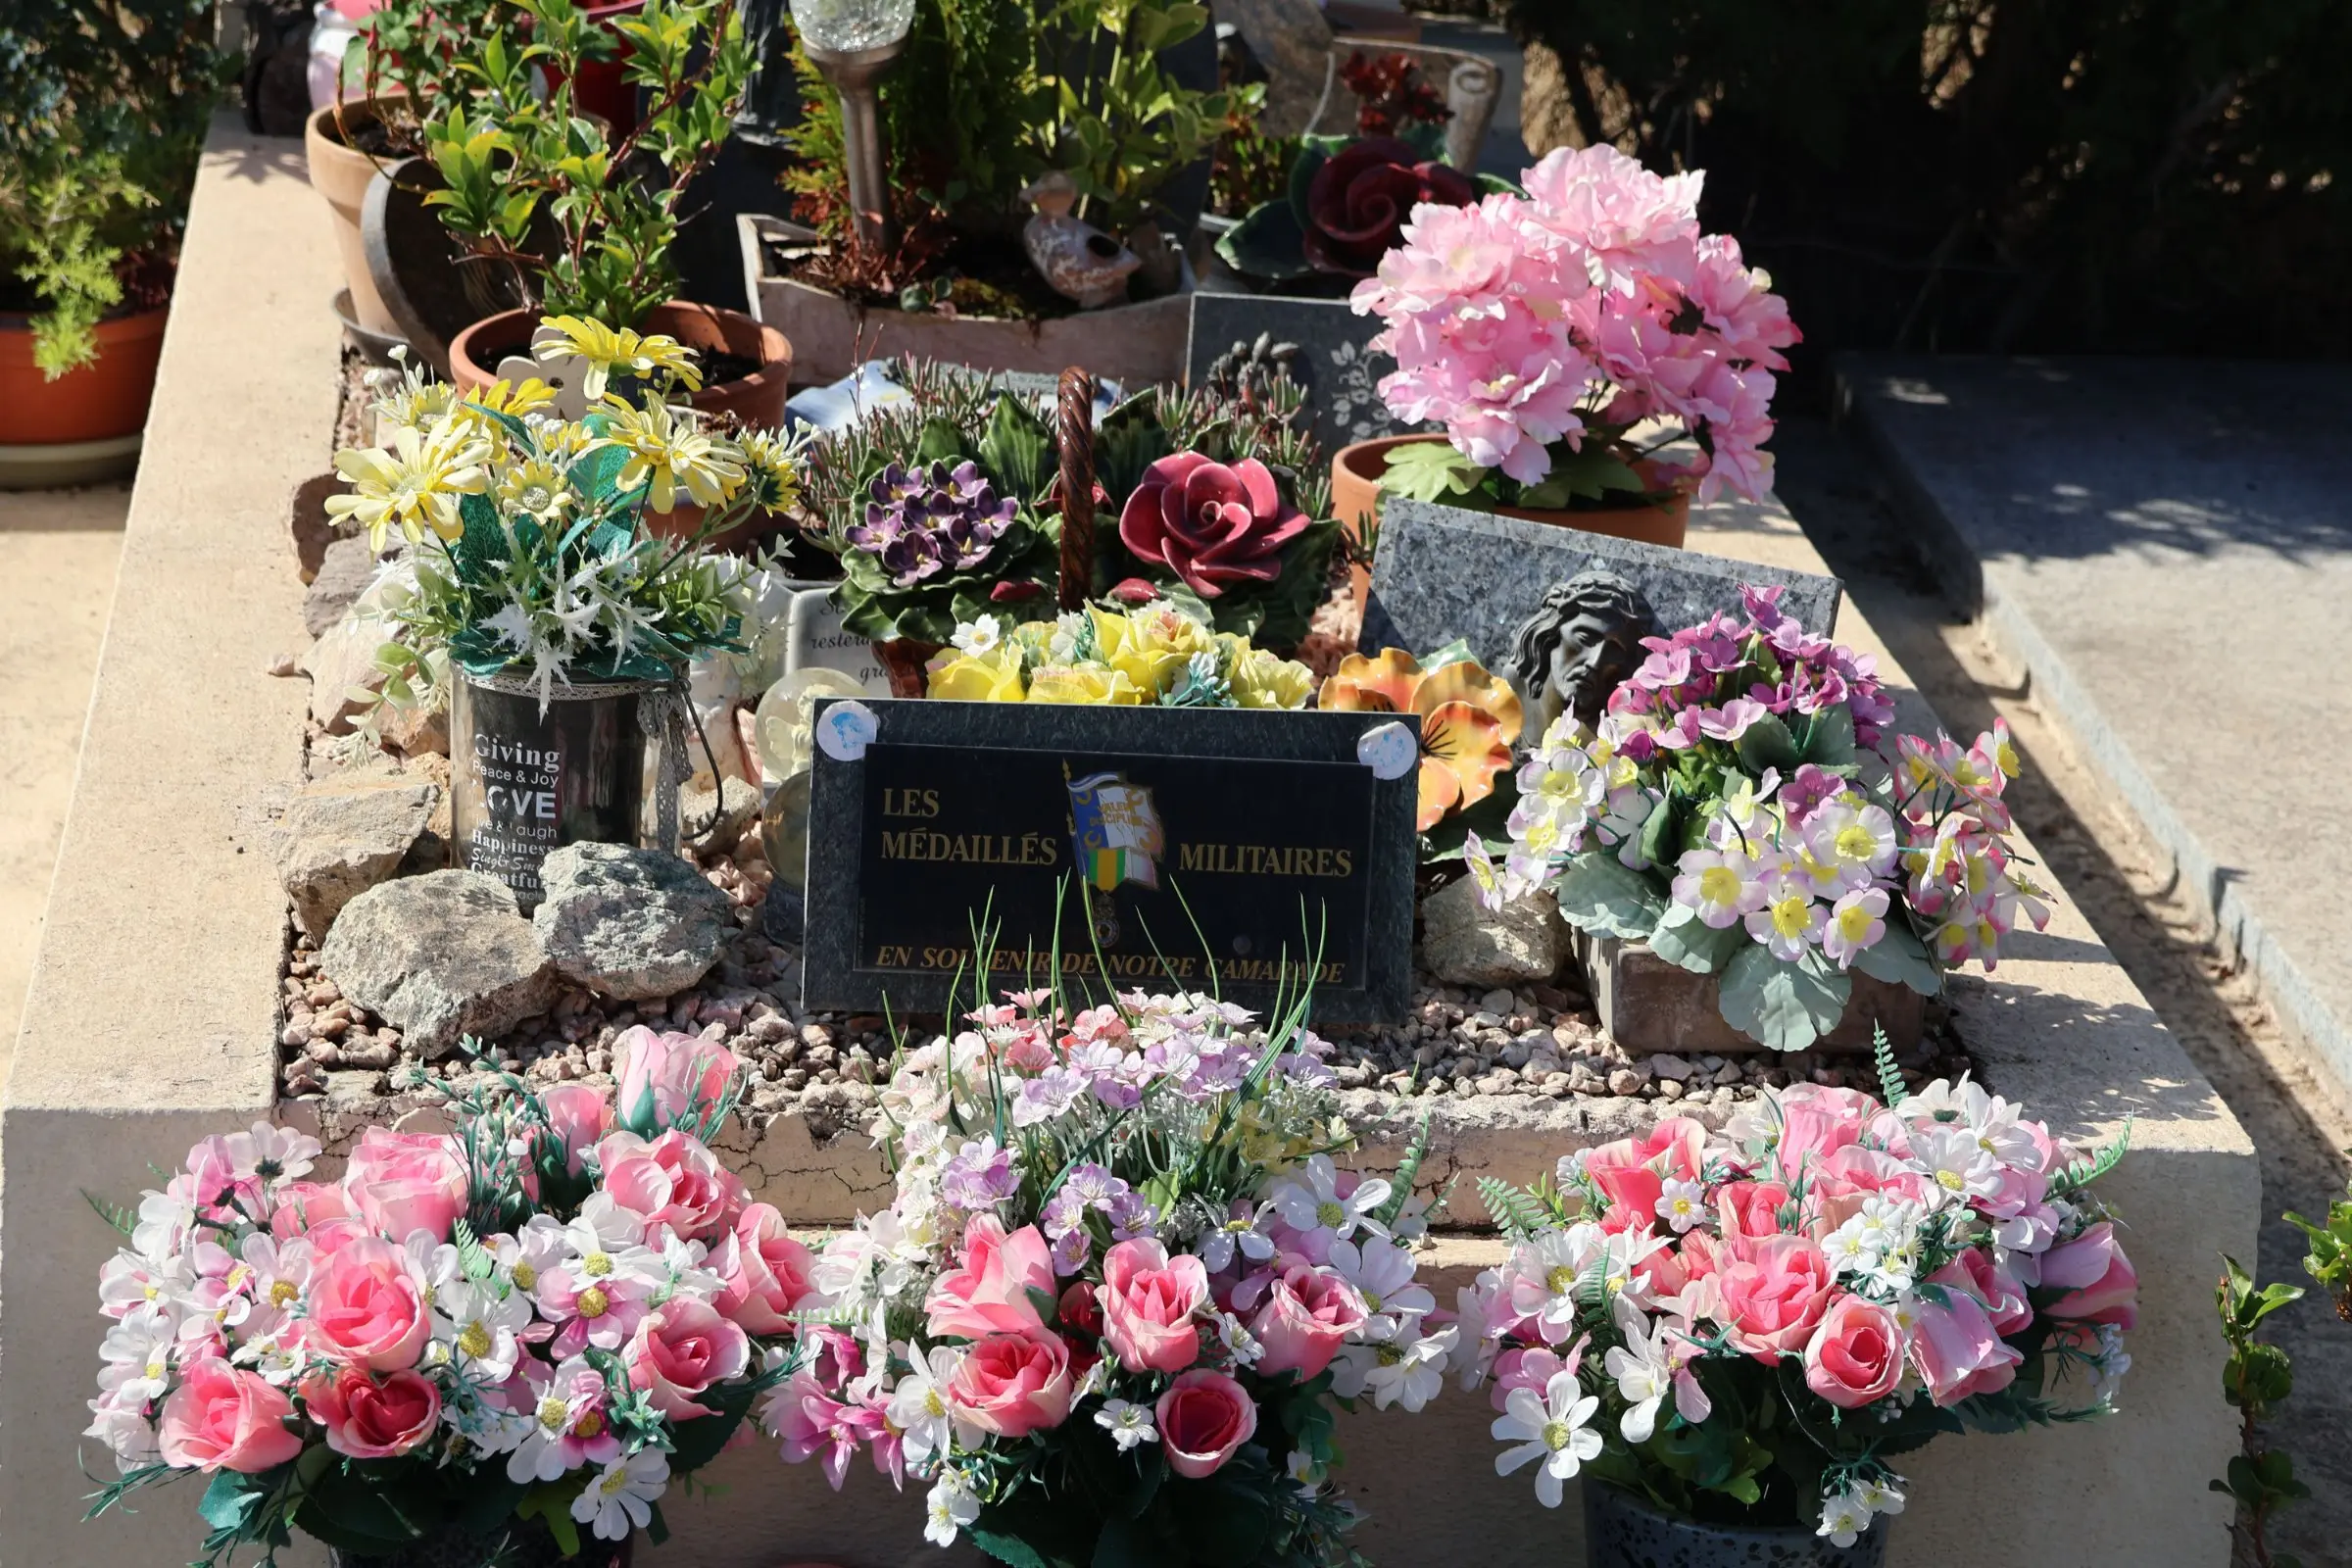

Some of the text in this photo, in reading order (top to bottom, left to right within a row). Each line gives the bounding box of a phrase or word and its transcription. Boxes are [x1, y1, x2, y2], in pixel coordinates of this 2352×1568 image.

[474, 733, 561, 773] Giving
[472, 760, 559, 789] Peace & Joy
[472, 779, 557, 819] OVE
[883, 787, 941, 818] LES
[510, 822, 558, 840] augh
[881, 826, 1353, 878] MÉDAILLÉS MILITAIRES
[875, 946, 1347, 984] EN SOUENIR DE NOTRE CAMARADE
